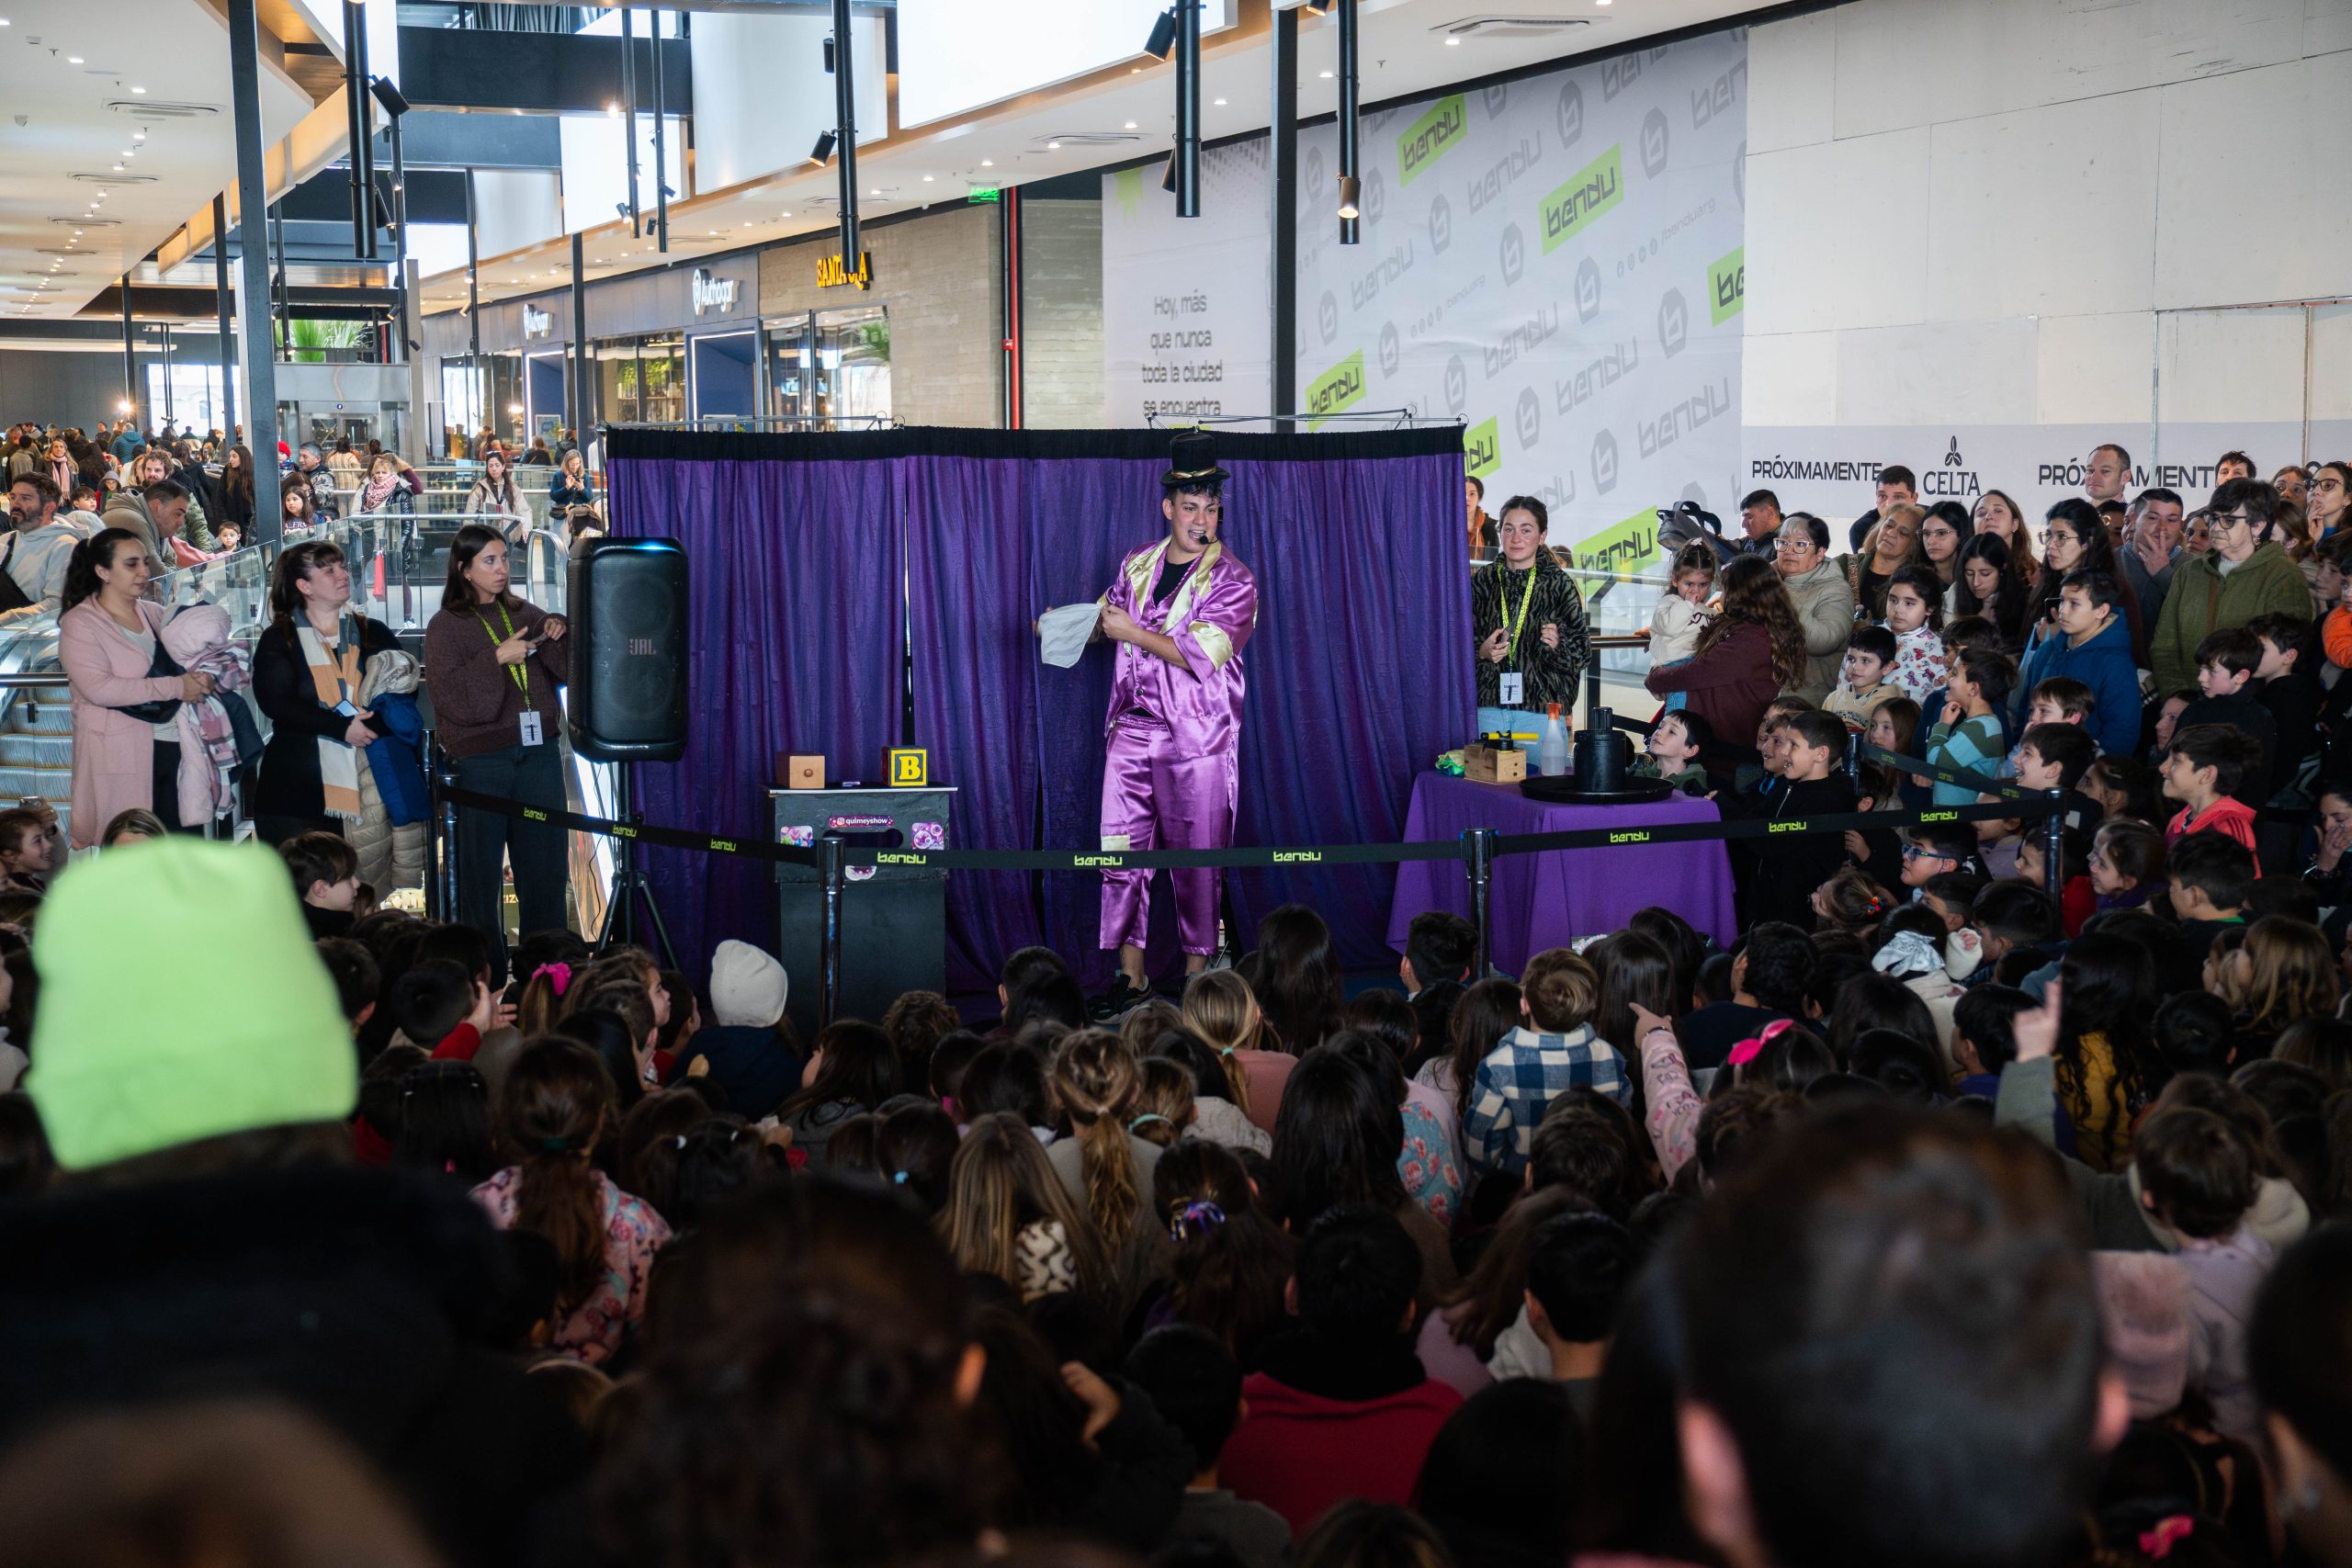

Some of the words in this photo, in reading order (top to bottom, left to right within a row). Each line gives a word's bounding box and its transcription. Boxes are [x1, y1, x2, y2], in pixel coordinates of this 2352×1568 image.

[1404, 104, 1461, 172] bendu
[1468, 130, 1543, 215] bendu
[1546, 166, 1615, 238] bendu
[1351, 239, 1413, 311] bendu
[701, 277, 733, 312] Authogar
[1154, 296, 1178, 321] Hoy,
[1182, 288, 1207, 313] más
[1150, 332, 1171, 355] que
[1176, 330, 1212, 347] nunca
[1484, 301, 1559, 379] bendu
[1142, 362, 1167, 382] toda
[1170, 361, 1180, 382] la
[1183, 359, 1222, 382] ciudad
[1555, 335, 1639, 415] bendu
[1160, 397, 1221, 416] encuentra
[1637, 377, 1730, 459] bendu
[1752, 455, 1883, 481] PRÓXIMAMENTE
[1923, 471, 1982, 496] CELTA
[628, 638, 657, 656] JBL
[899, 756, 921, 780] B
[524, 807, 547, 821] bendu
[845, 817, 888, 826] quimeyshow
[1920, 811, 1958, 822] bendu
[613, 825, 638, 838] bendu
[1610, 831, 1650, 843] bendu
[1769, 822, 1806, 833] bendu
[710, 839, 737, 852] bendu
[1273, 851, 1322, 863] bendu
[877, 852, 926, 864] bendu
[1074, 855, 1123, 867] bendu
